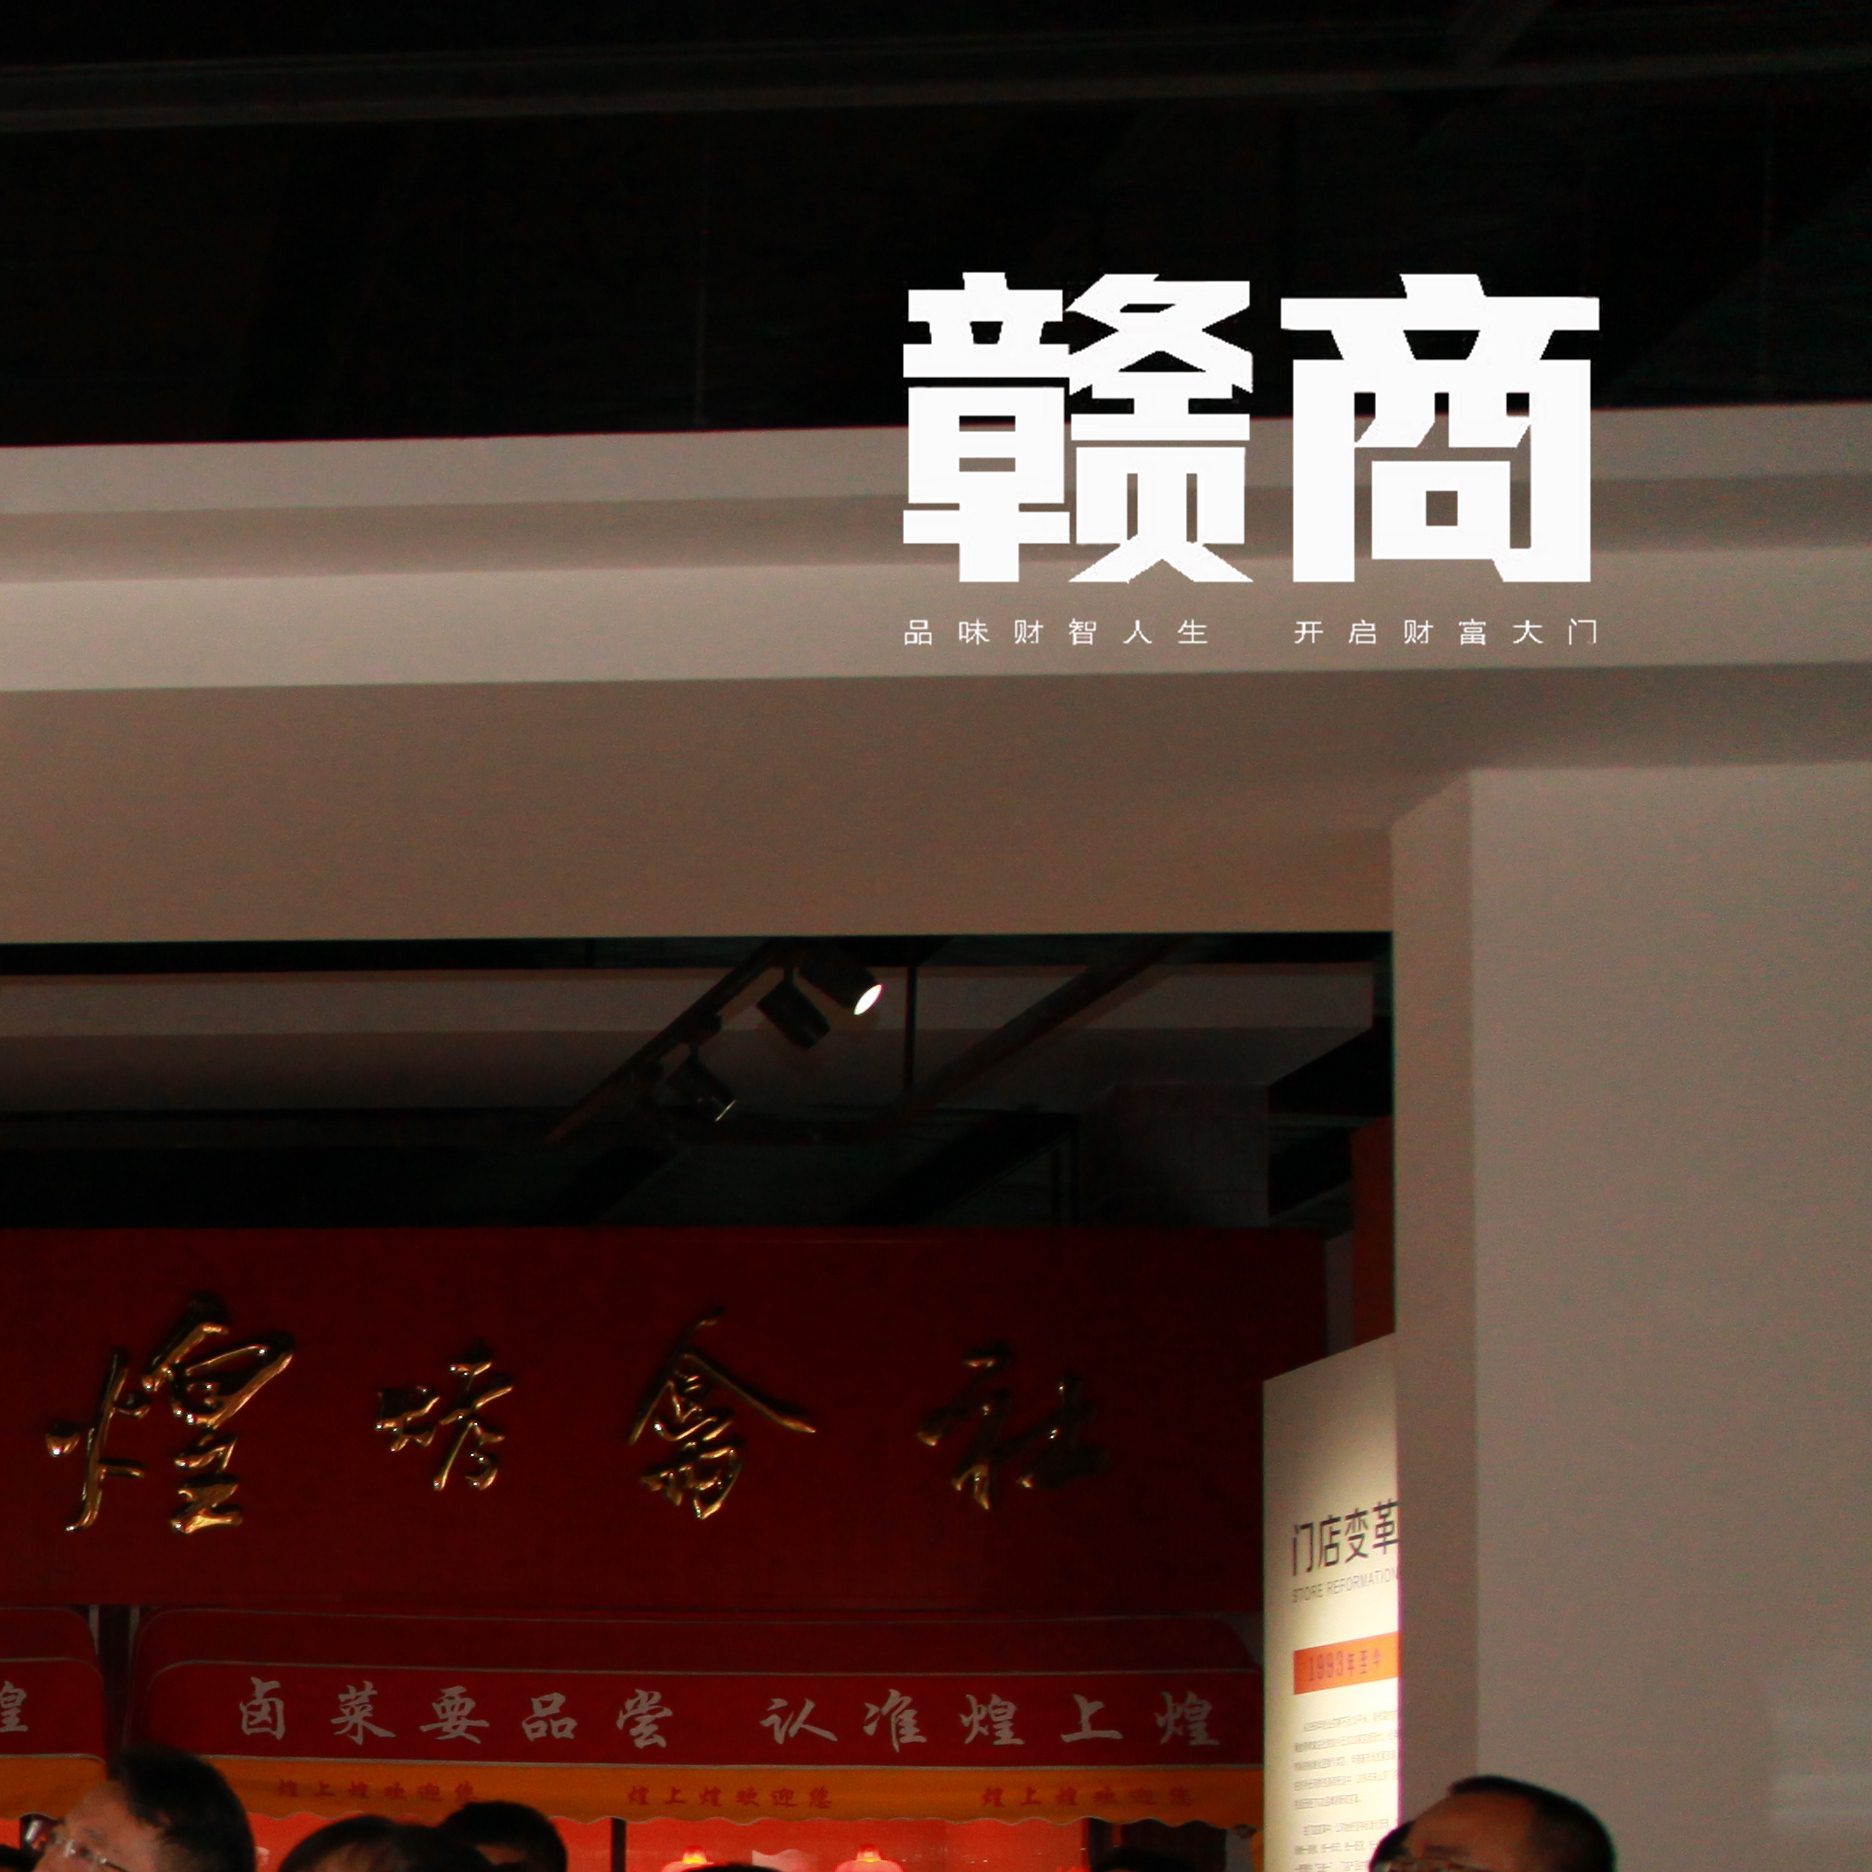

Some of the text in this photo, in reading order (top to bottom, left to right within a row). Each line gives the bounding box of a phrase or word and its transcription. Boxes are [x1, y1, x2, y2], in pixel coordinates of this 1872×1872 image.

[1292, 1498, 1399, 1576] 门店变革
[1292, 1582, 1323, 1604] STORE
[238, 1676, 1221, 1754] 卤菜要品尝 认准煌上煌
